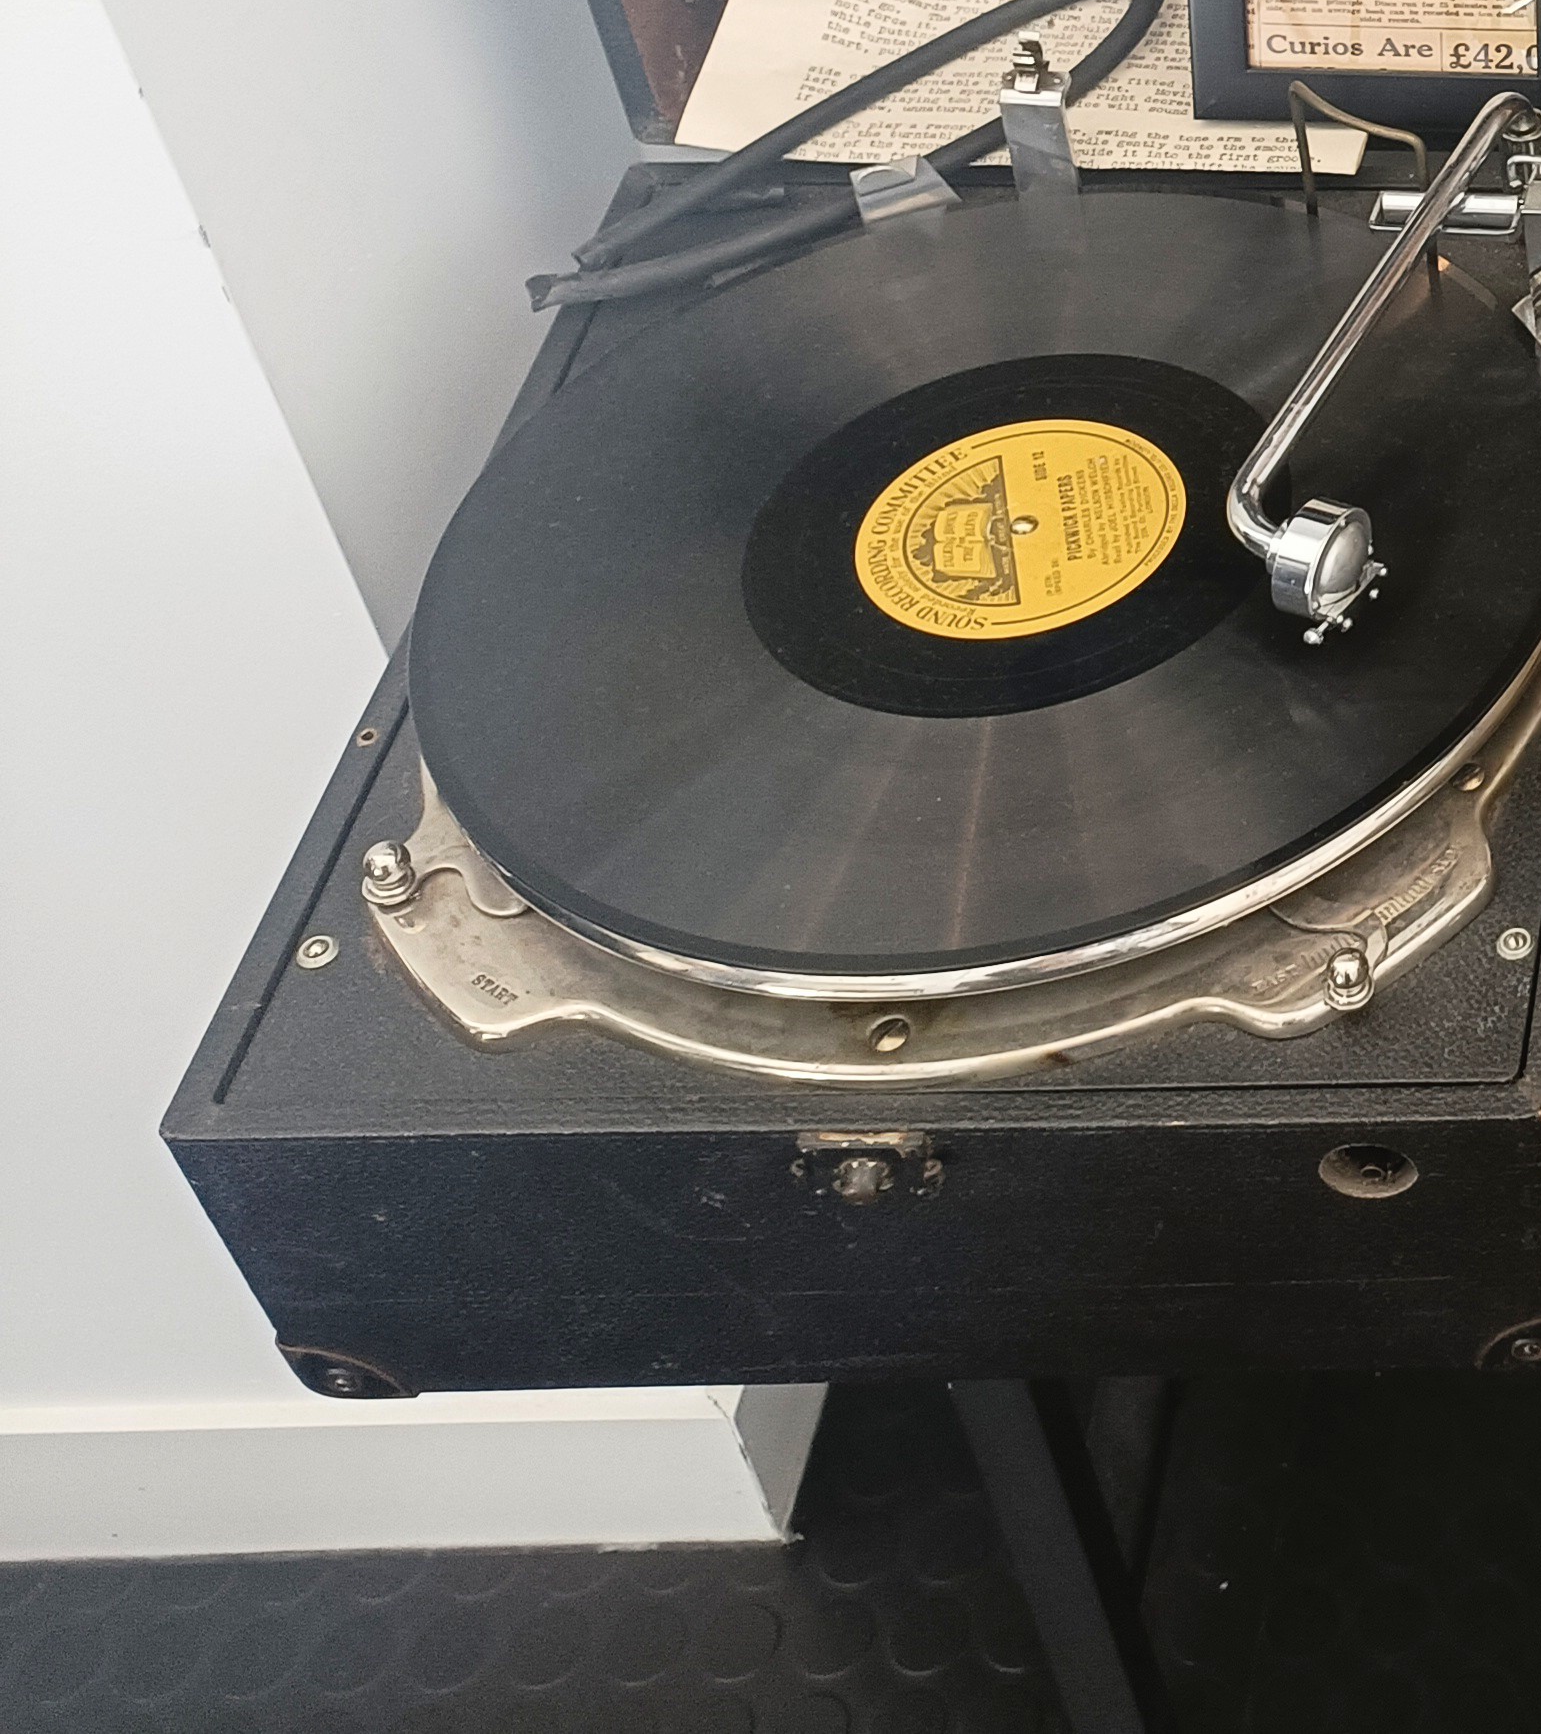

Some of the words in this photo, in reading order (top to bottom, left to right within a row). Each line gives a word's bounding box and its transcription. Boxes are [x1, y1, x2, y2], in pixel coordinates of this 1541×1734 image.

[1266, 34, 1363, 56] Curios
[1377, 37, 1432, 57] Are
[871, 447, 968, 535] COMMITTEE
[1057, 474, 1077, 513] PAPERS
[1063, 513, 1083, 561] PICKWICK
[868, 539, 919, 612] RECORDING
[916, 605, 988, 630] SOUND
[471, 974, 519, 1005] START
